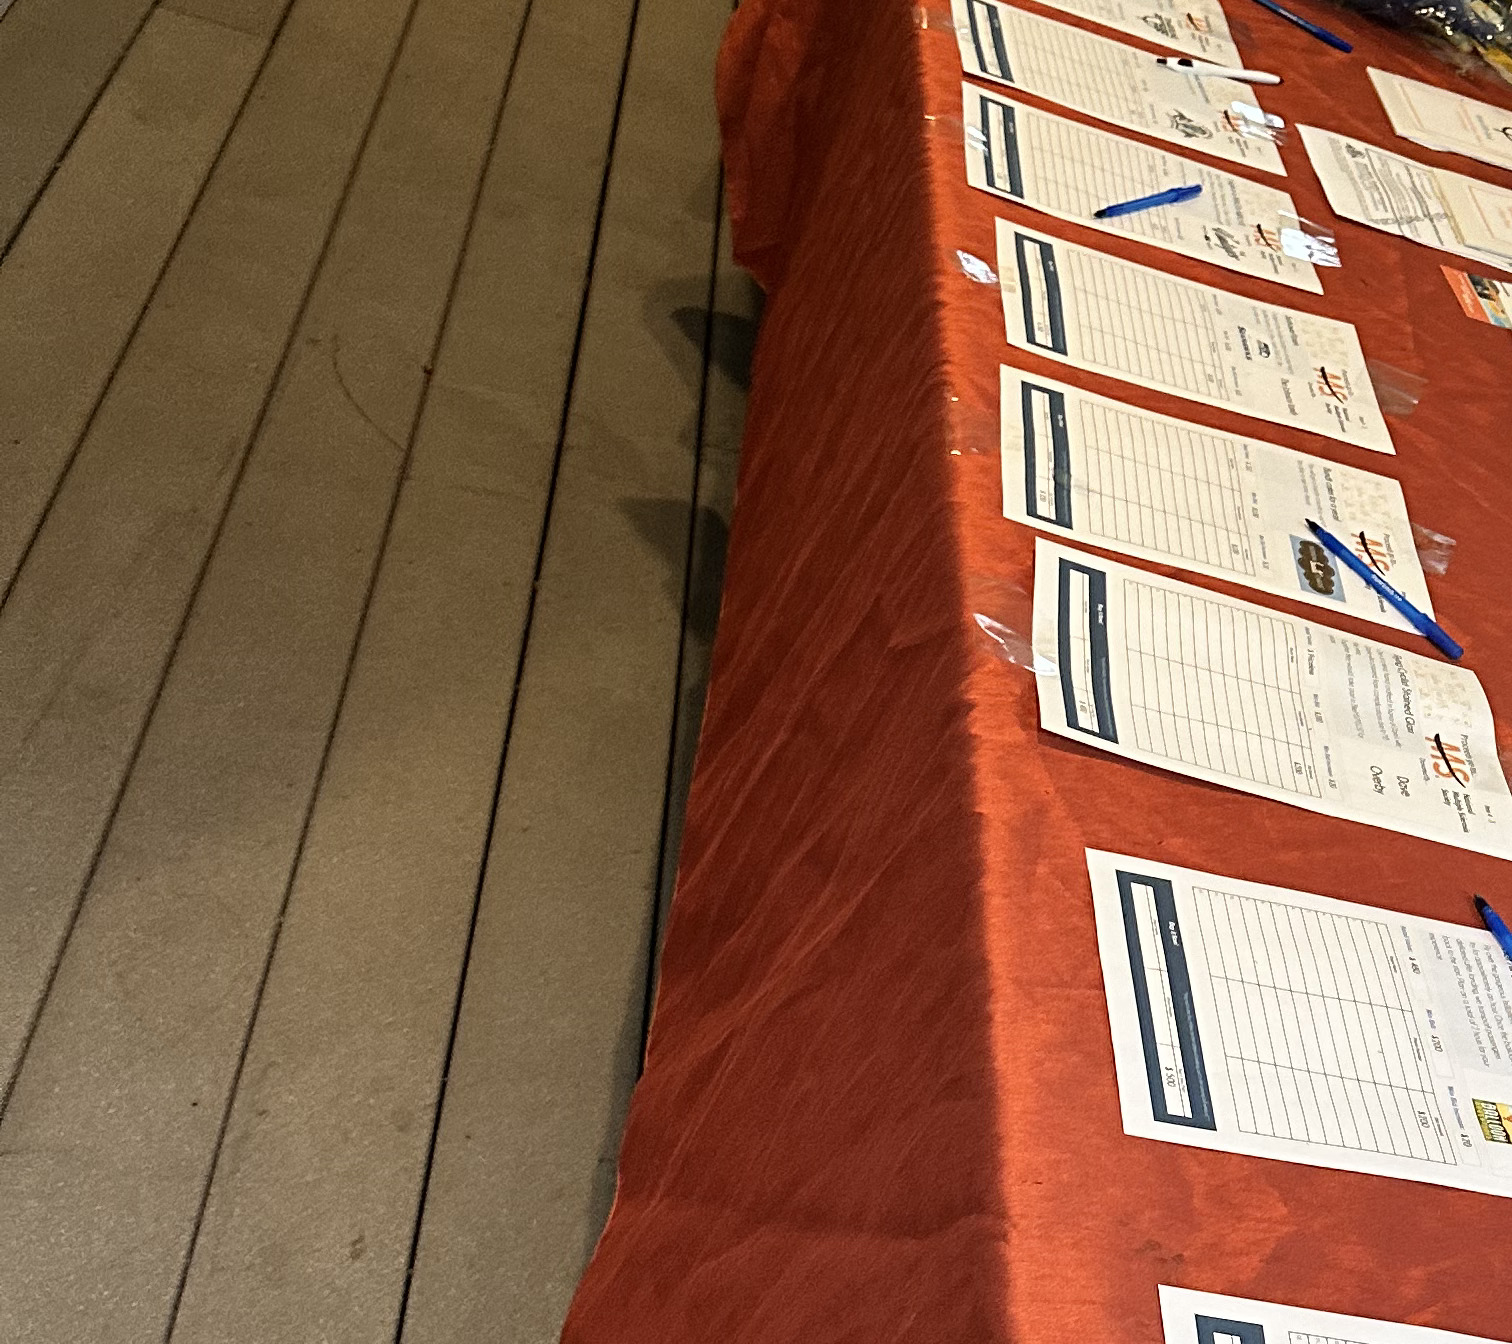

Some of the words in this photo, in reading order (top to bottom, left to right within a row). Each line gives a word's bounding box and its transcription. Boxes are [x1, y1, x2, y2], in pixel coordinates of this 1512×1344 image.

[1401, 687, 1413, 716] Stained
[1404, 716, 1415, 734] Glass
[1426, 737, 1468, 781] MS
[1369, 765, 1384, 794] Overby
[1396, 775, 1409, 796] Dave
[1480, 1102, 1509, 1143] BALLOON
